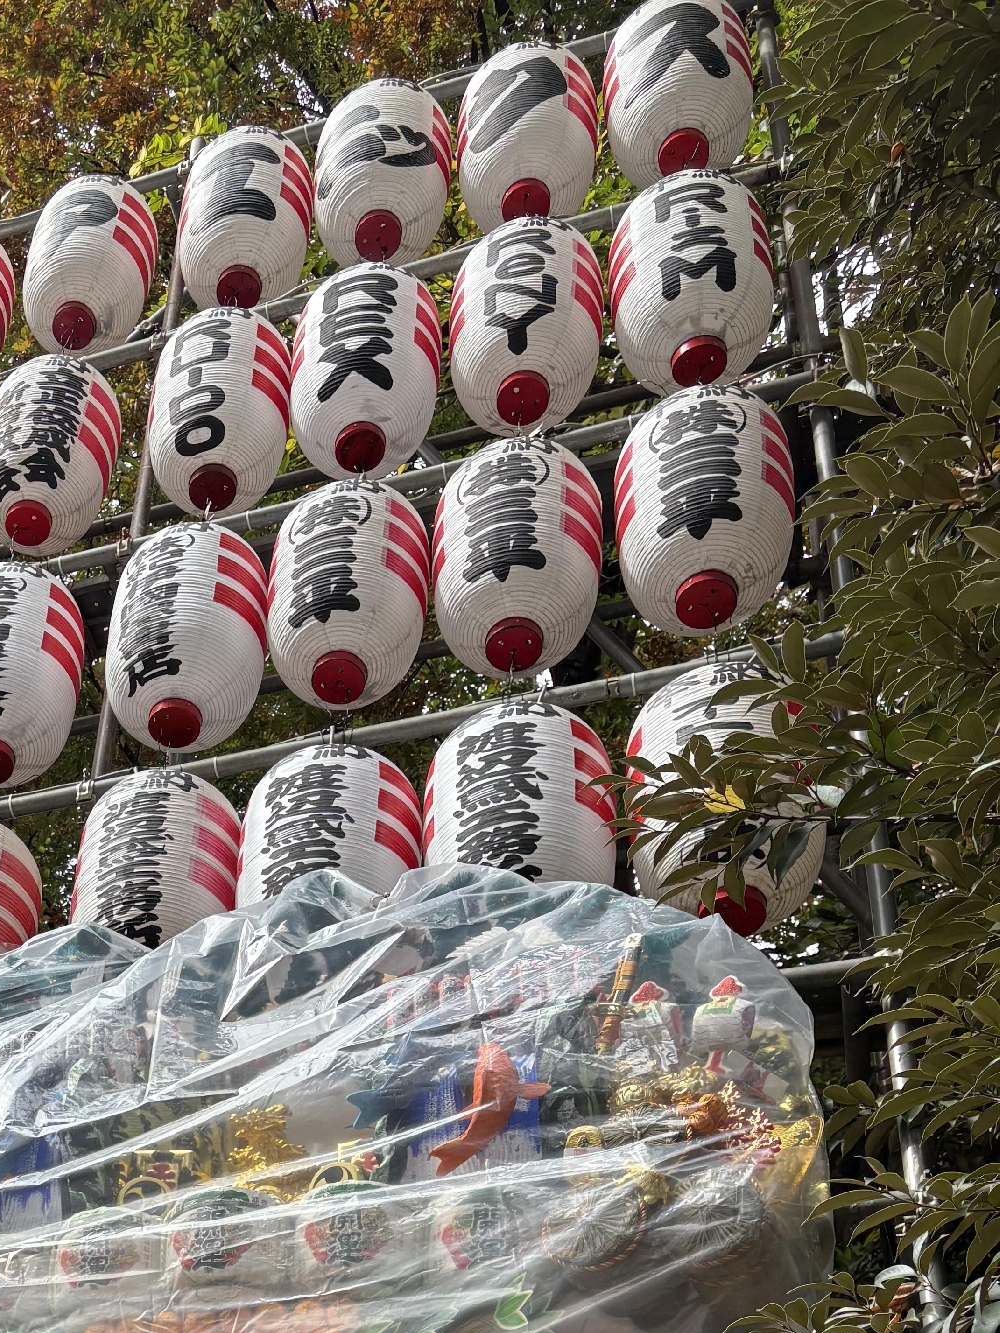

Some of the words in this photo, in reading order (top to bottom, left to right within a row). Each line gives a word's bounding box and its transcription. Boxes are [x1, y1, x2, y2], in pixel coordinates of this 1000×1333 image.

[167, 318, 233, 458] RUIDO
[316, 272, 399, 403] REX
[456, 453, 550, 583] (株)三平
[648, 399, 748, 541] (株)三平
[287, 495, 373, 629] (株)三平
